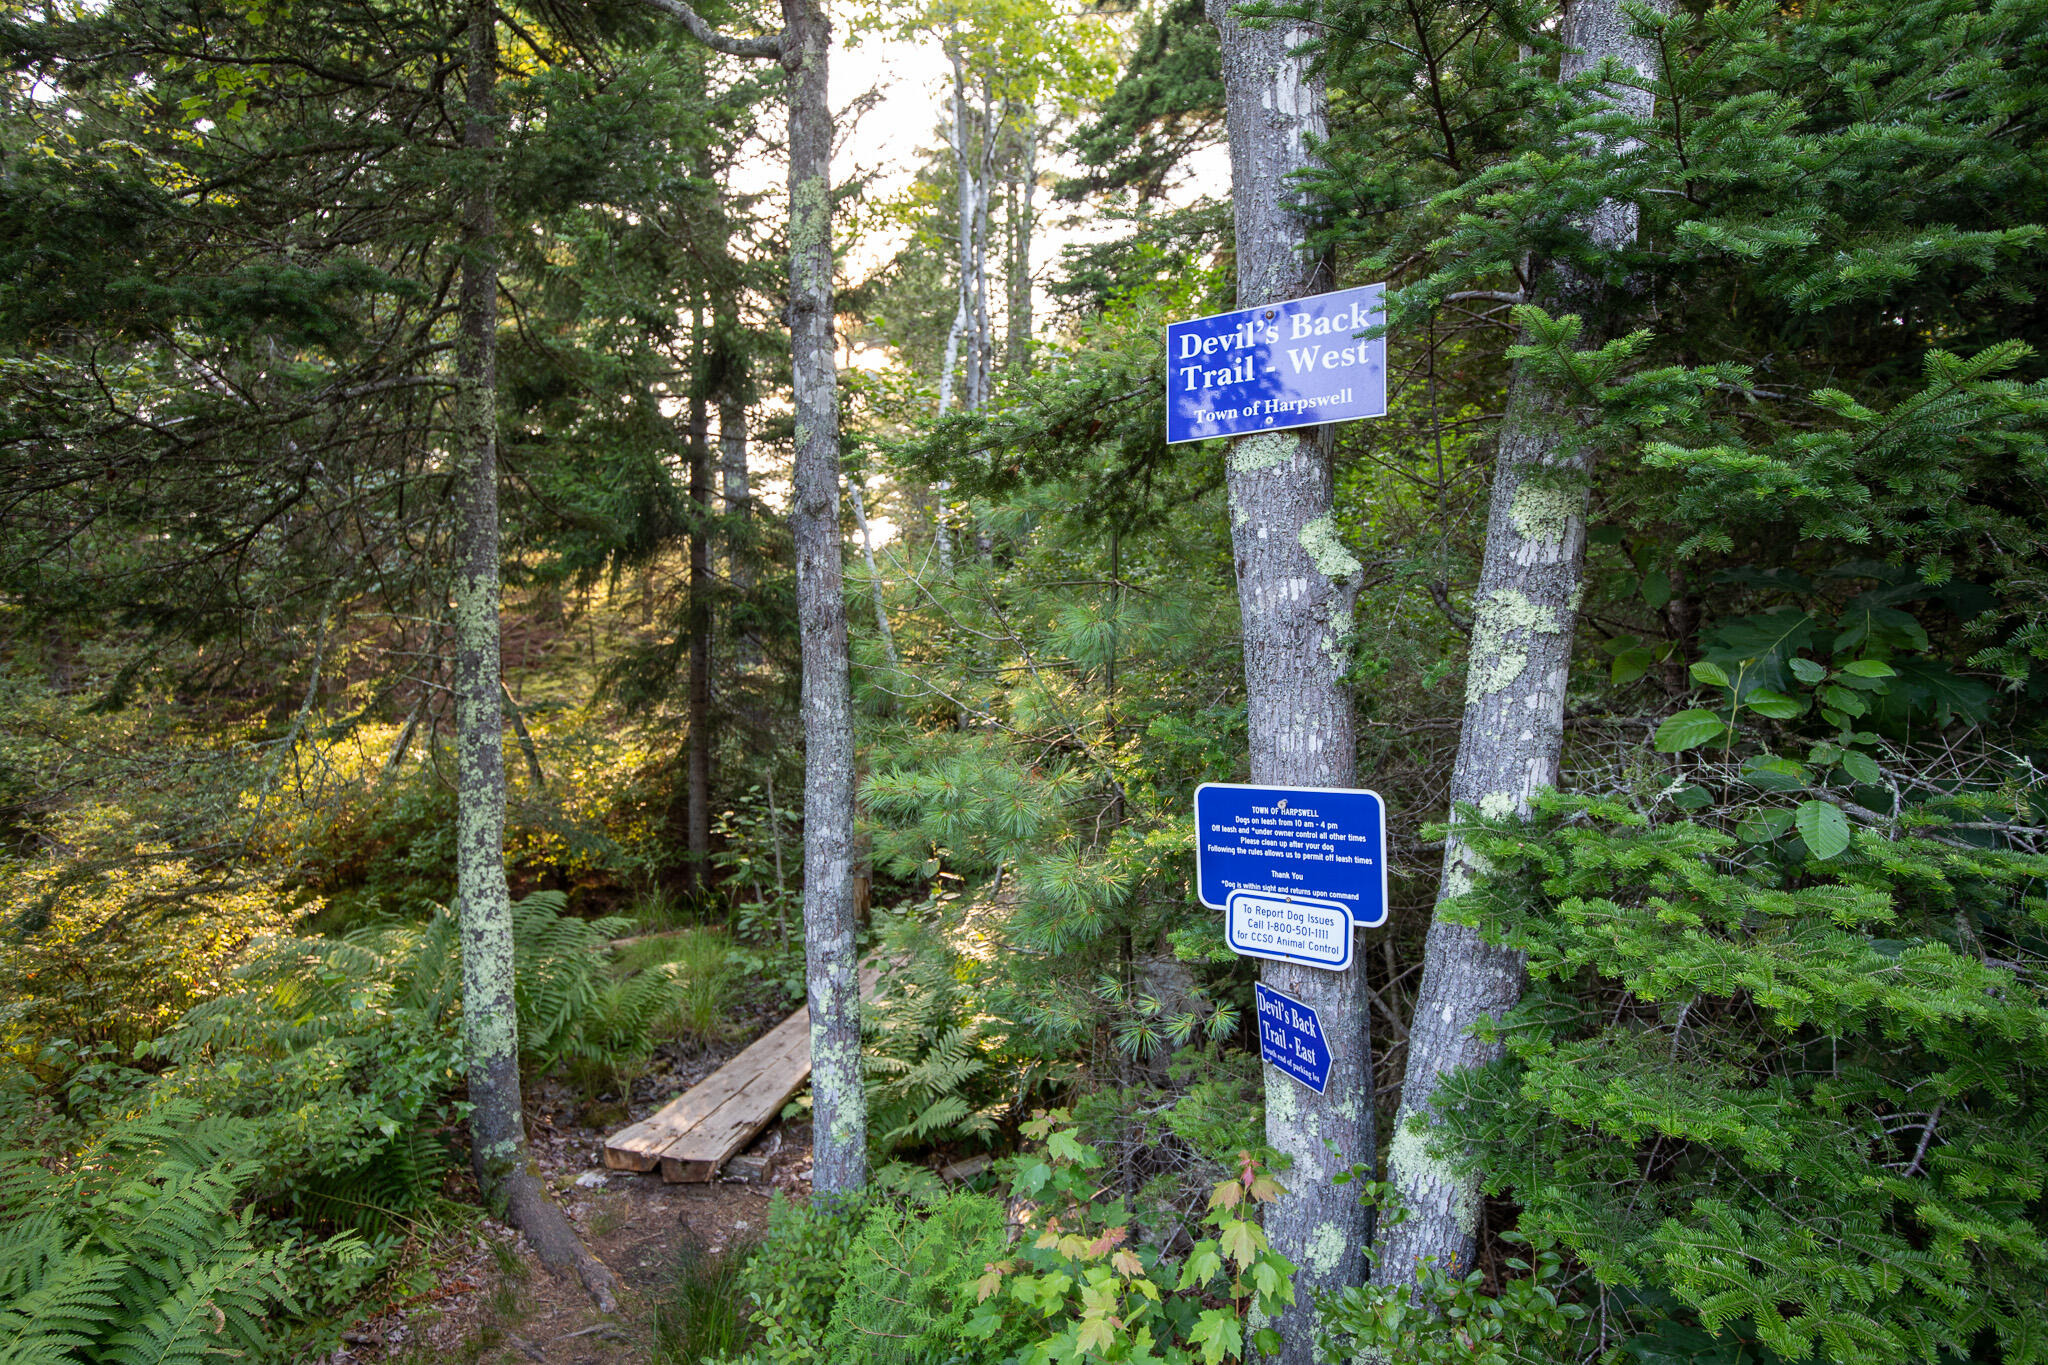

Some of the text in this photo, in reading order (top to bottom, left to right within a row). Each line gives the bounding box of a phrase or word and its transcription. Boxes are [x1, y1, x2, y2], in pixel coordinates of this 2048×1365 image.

[1179, 302, 1370, 359] Devil's Back
[1180, 355, 1255, 391] Trail
[1287, 341, 1369, 374] West
[1194, 388, 1352, 423] Town of Harpswell
[1235, 816, 1250, 825] Dogs
[1261, 817, 1277, 826] leash
[1278, 818, 1293, 827] from
[1295, 819, 1302, 828] 10
[1320, 821, 1325, 829] 4
[1327, 822, 1338, 830] pm
[1252, 806, 1319, 818] TOWN OF HARPSWELL
[1211, 824, 1220, 832] Off
[1222, 825, 1237, 834] leash
[1238, 826, 1249, 834] and
[1295, 830, 1317, 839] control
[1319, 832, 1327, 840] all
[1329, 832, 1346, 841] other
[1348, 834, 1366, 843] times
[1240, 836, 1334, 853] Please clean up after your dog
[1207, 844, 1235, 855] Following
[1236, 846, 1247, 855] the
[1248, 848, 1263, 856] rules
[1264, 849, 1284, 858] allows
[1294, 851, 1301, 859] to
[1302, 852, 1323, 861] permit
[1325, 853, 1334, 862] off
[1335, 854, 1352, 864] leash
[1354, 855, 1373, 865] times
[1271, 869, 1304, 880] Thank You
[1236, 881, 1242, 889] is
[1242, 882, 1261, 890] within
[1262, 884, 1276, 893] sight
[1277, 885, 1289, 893] and
[1290, 887, 1311, 896] returns
[1312, 889, 1328, 898] upon
[1329, 891, 1360, 901] command
[1243, 904, 1335, 927] To Report Dog Issues
[1247, 918, 1329, 940] Call 1-800-501-1111
[1237, 930, 1339, 955] for CCSO Animal Control
[1258, 991, 1317, 1039] Devil's Back
[1262, 1020, 1287, 1050] Trail
[1294, 1036, 1317, 1067] East
[1263, 1044, 1321, 1083] South end of parking lot
